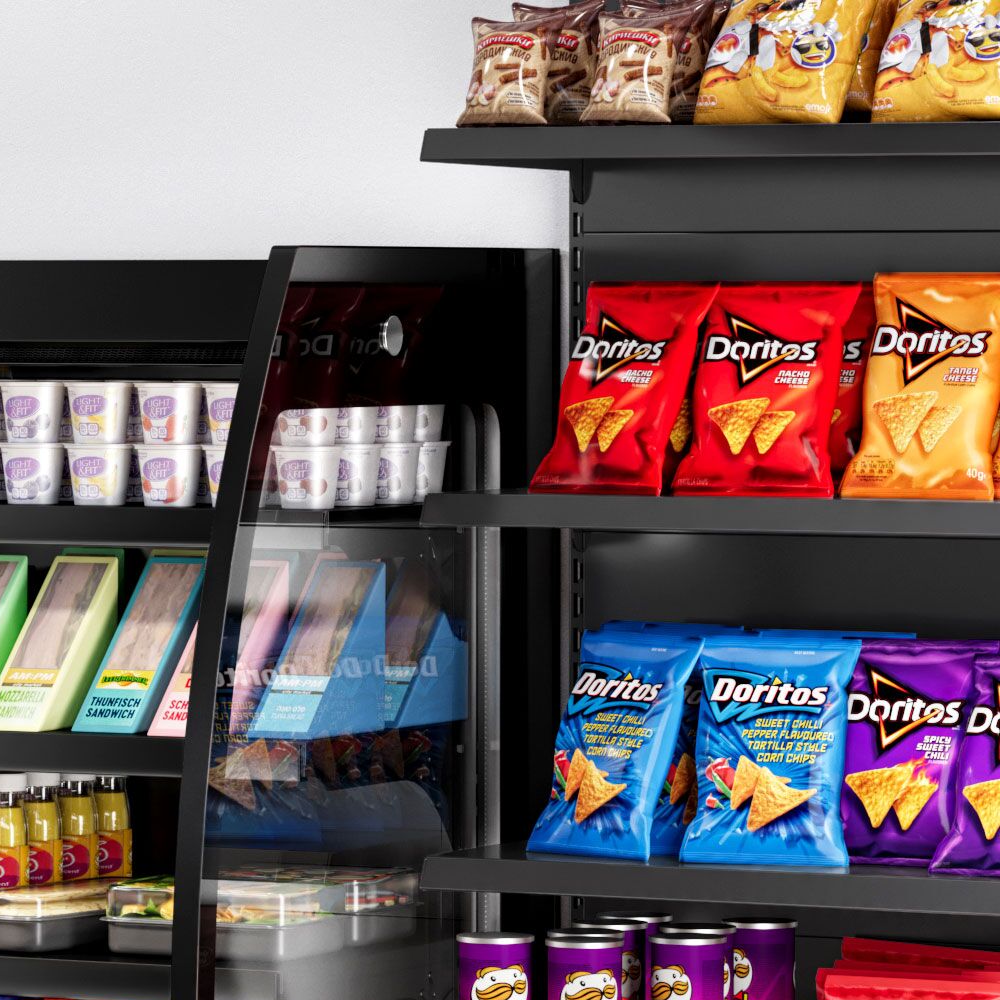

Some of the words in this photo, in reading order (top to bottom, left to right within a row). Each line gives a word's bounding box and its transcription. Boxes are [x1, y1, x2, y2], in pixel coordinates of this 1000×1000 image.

[873, 327, 987, 354] Doritos
[571, 336, 665, 360] Doritos
[707, 336, 817, 361] Doritos
[774, 377, 809, 385] CHEESE
[943, 375, 977, 383] CHEESE
[9, 399, 32, 407] LIGHT
[76, 397, 100, 405] LIGHT
[148, 399, 170, 407] LIGHT
[9, 460, 32, 469] LIGHT
[76, 459, 100, 467] LIGHT
[148, 461, 170, 469] LIGHT
[572, 672, 662, 701] Doritos
[711, 678, 828, 705] Doritos
[91, 697, 141, 707] THUNFISCH
[86, 708, 135, 719] SANDWICH
[848, 694, 961, 724] Doritos
[595, 713, 622, 721] SWEET
[622, 715, 646, 724] CHILLI
[755, 718, 789, 727] SWEET
[792, 720, 823, 729] CHILLI
[582, 723, 609, 732] PEPPER
[609, 725, 653, 737] FLAVOURED
[742, 730, 778, 738] PEPPER
[780, 730, 834, 741] FLAVOURED
[584, 735, 616, 745] TORTILLA
[617, 737, 643, 748] STYLE
[748, 741, 793, 751] TORTILLA
[795, 742, 827, 752] STYLE
[587, 746, 607, 756] CORN
[608, 748, 632, 759] CHIPS
[925, 751, 949, 760] CHILI
[757, 753, 784, 762] CORN
[786, 753, 816, 764] CHIPS
